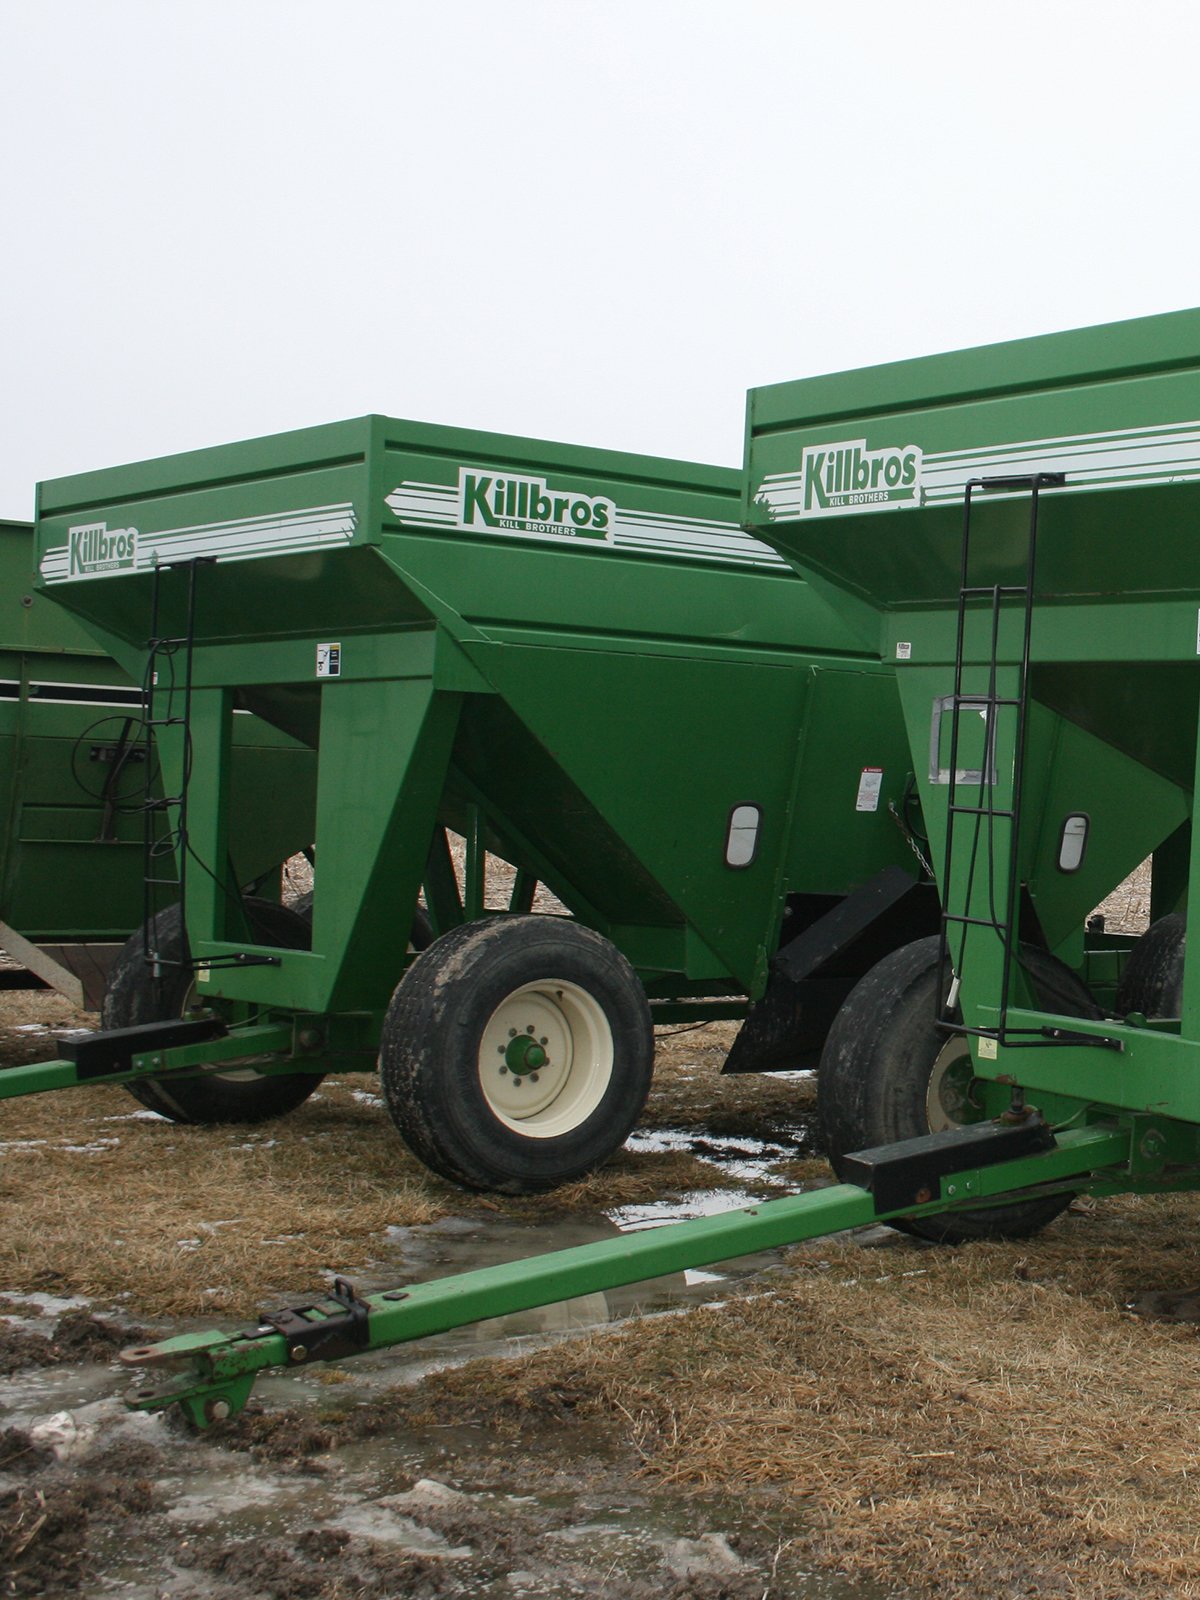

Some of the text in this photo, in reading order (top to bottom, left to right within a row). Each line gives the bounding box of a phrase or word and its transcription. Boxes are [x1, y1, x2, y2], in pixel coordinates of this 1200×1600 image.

[463, 474, 609, 529] Killbros
[804, 447, 917, 511] Killbros
[829, 491, 889, 507] KILL BROTHERS
[499, 519, 576, 536] KILL BROTHERS
[70, 528, 135, 576] Killbros
